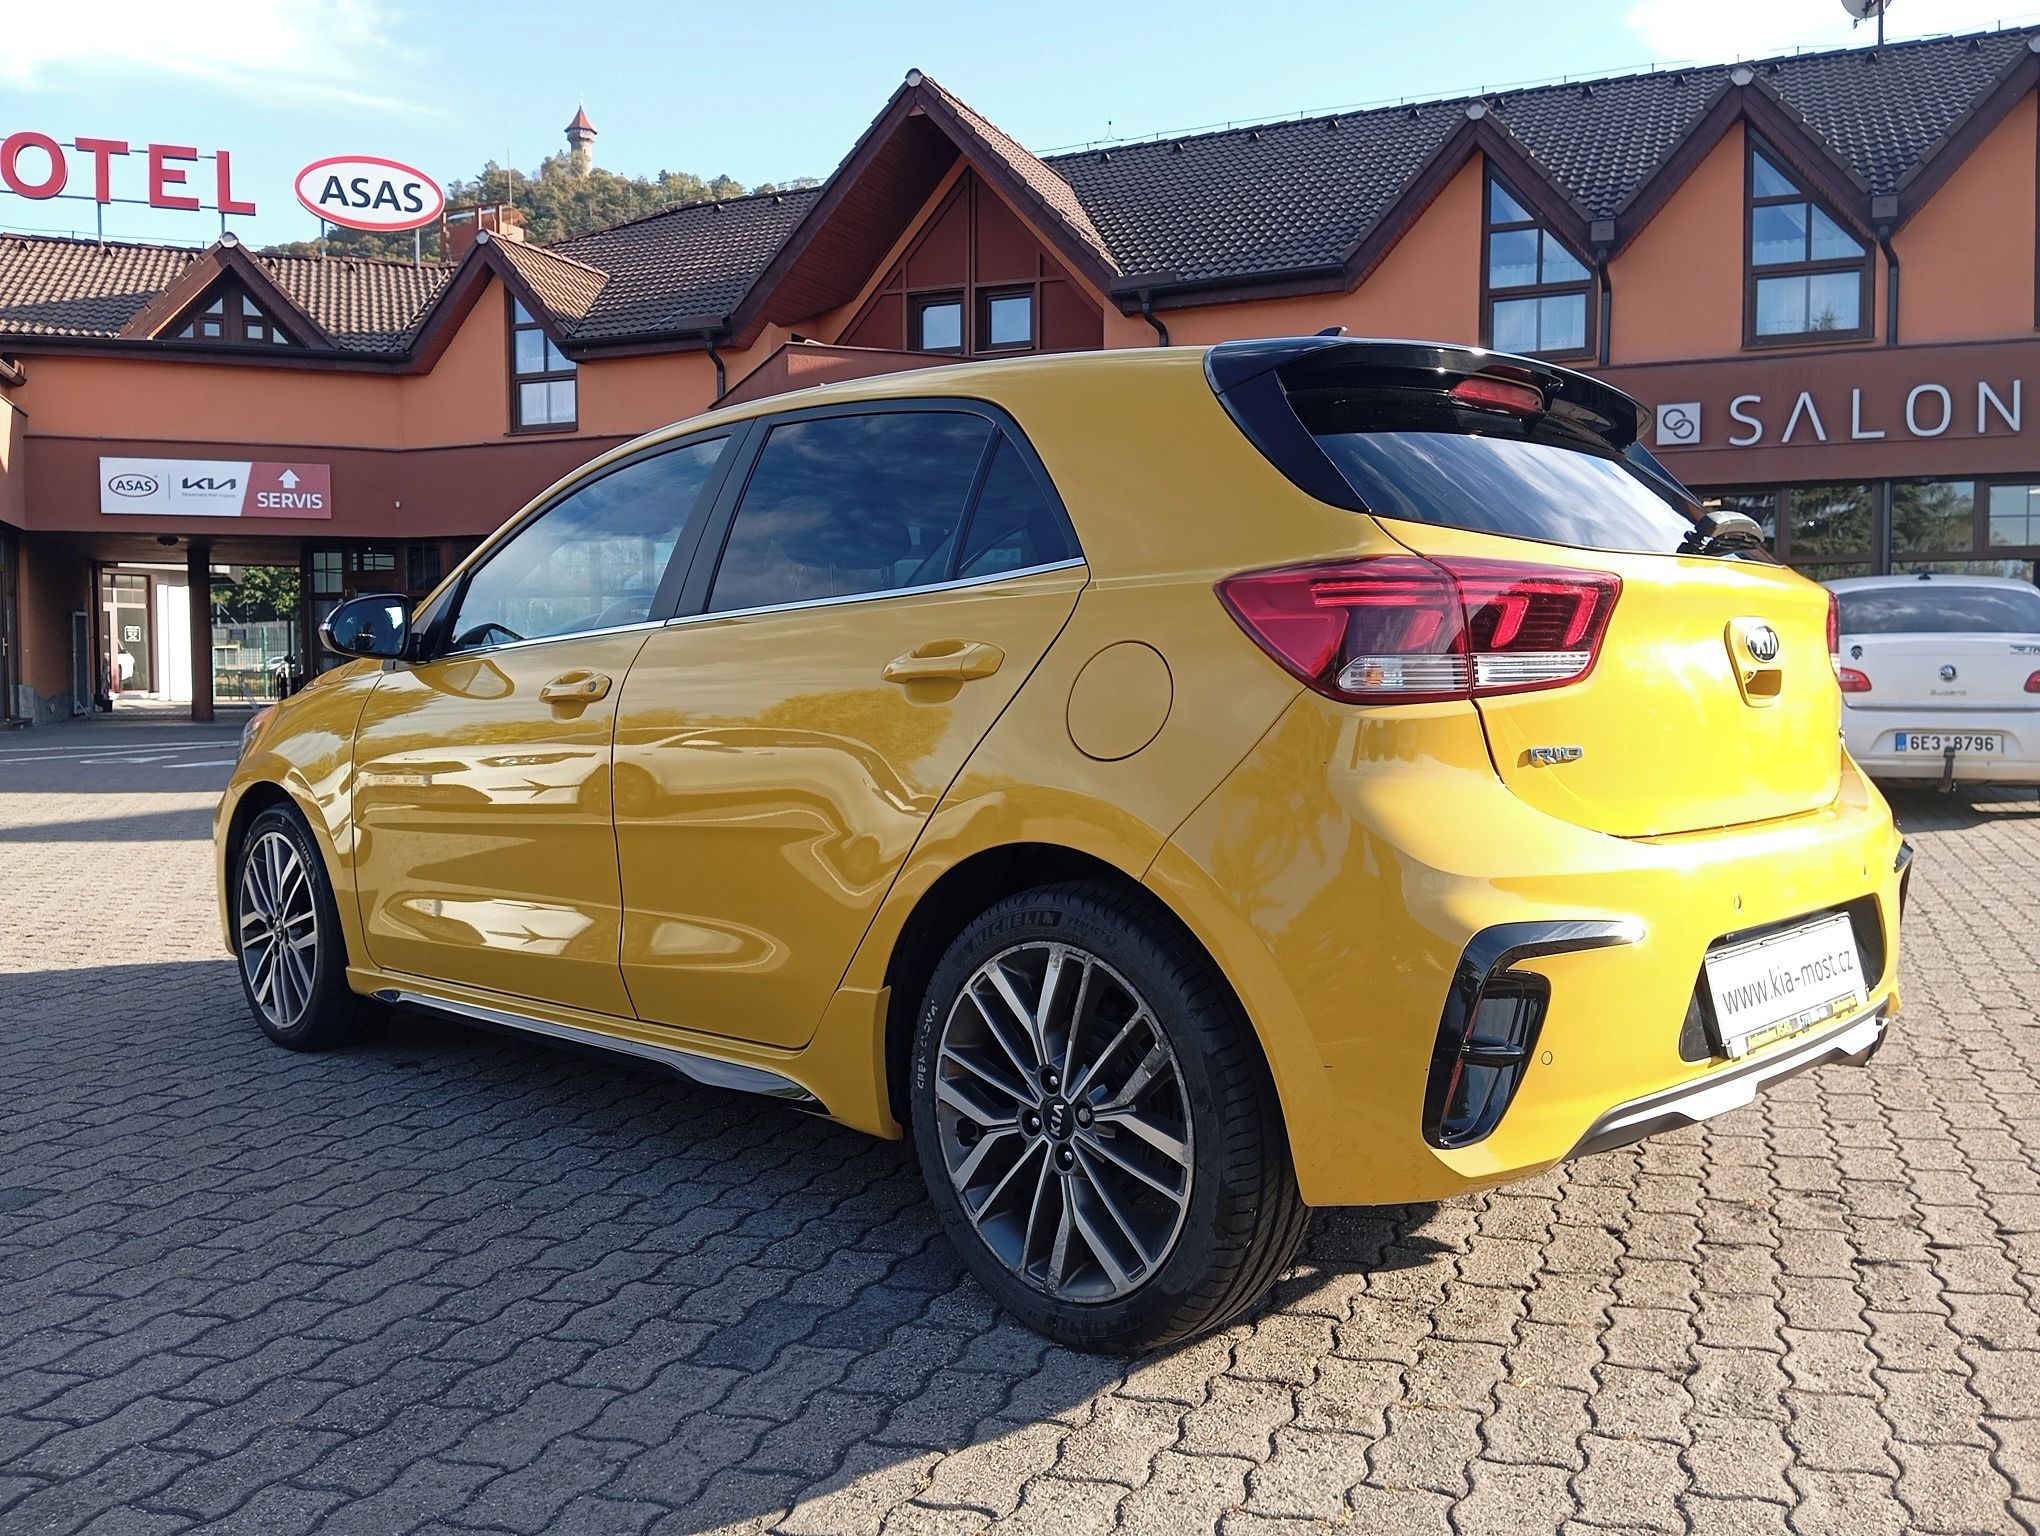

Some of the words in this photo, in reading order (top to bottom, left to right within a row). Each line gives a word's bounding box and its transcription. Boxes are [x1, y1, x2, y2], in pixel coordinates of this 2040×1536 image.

[0, 131, 256, 216] OTEL
[319, 175, 424, 213] ASAS
[1728, 379, 2022, 446] SALON
[115, 480, 152, 492] ASAS
[257, 492, 322, 509] SERVIS
[1530, 747, 1583, 763] RIO
[1910, 736, 1941, 750] 6E3
[1953, 736, 1994, 751] 8796
[1722, 950, 1853, 1014] www.kia-most.cz
[1050, 1104, 1065, 1137] KIA
